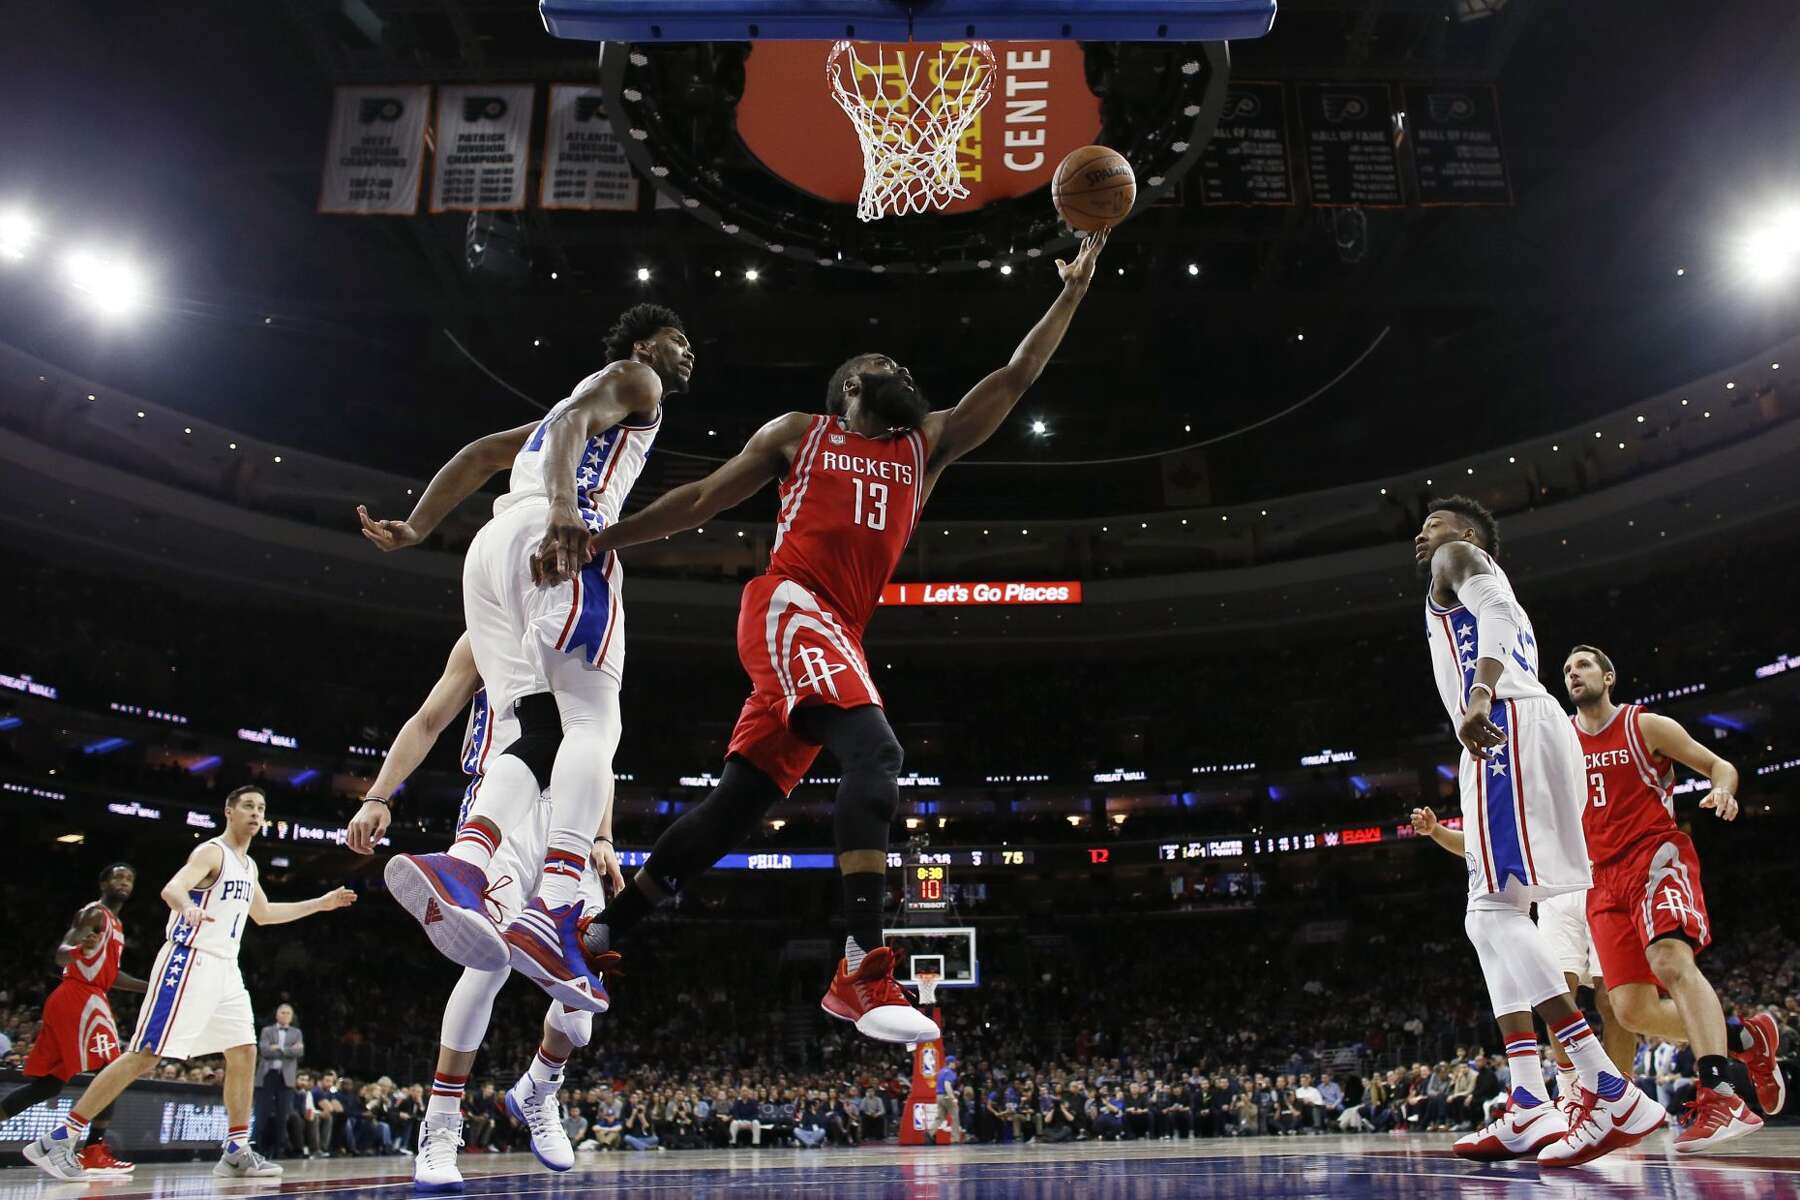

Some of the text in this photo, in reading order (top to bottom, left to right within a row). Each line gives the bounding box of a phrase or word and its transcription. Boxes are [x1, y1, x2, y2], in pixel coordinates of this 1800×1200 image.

[1003, 40, 1051, 172] CENTE
[822, 451, 912, 485] ROCKETS
[852, 478, 889, 531] 13
[923, 583, 1069, 602] Let's Go Places
[0, 675, 26, 691] REAT
[1584, 749, 1629, 769] CKETS
[1094, 771, 1146, 783] GREAT WALL
[1343, 829, 1380, 842] RAW
[1002, 851, 1024, 864] 75
[1211, 848, 1243, 857] POINTS
[748, 854, 792, 869] PHILA
[917, 867, 943, 880] 8:38
[921, 880, 940, 899] 10
